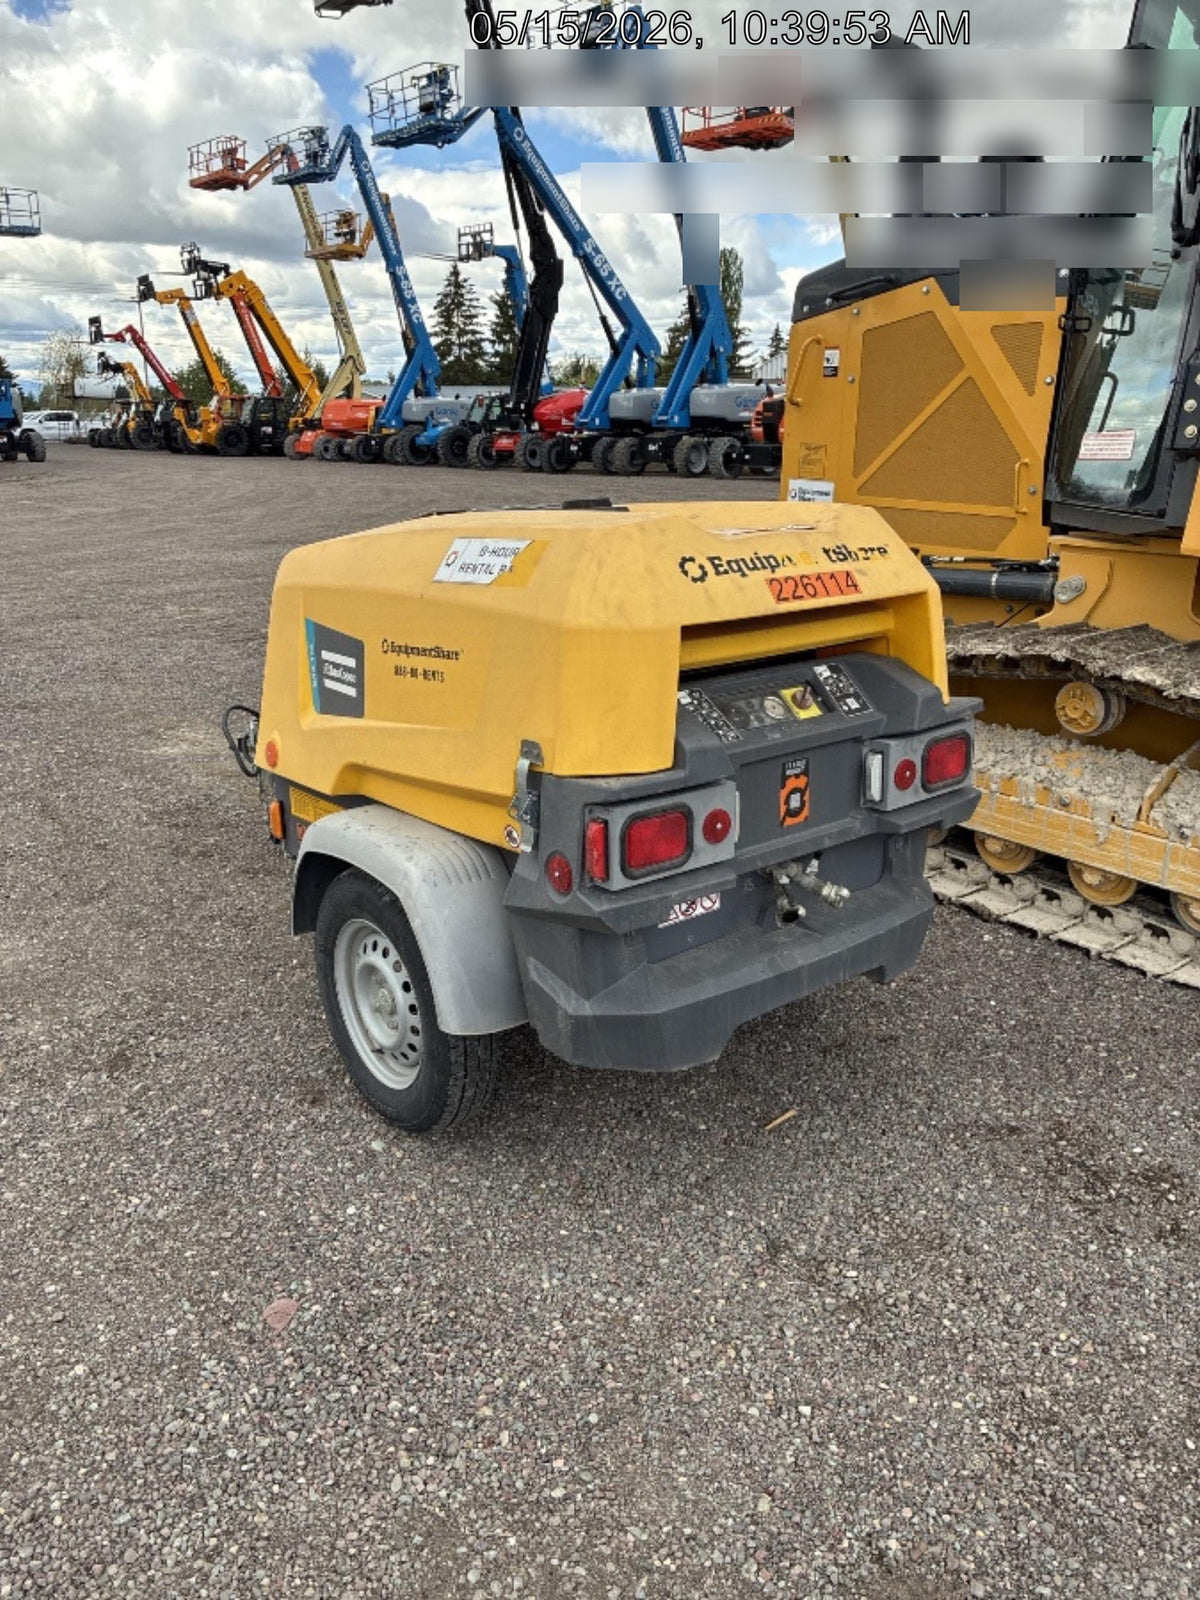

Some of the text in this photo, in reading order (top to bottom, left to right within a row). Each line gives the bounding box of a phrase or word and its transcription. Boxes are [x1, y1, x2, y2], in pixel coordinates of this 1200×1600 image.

[583, 238, 628, 300] S-65 XC
[396, 265, 423, 324] S-65 XC
[769, 571, 859, 602] 226114
[391, 640, 461, 660] EquipmentShare
